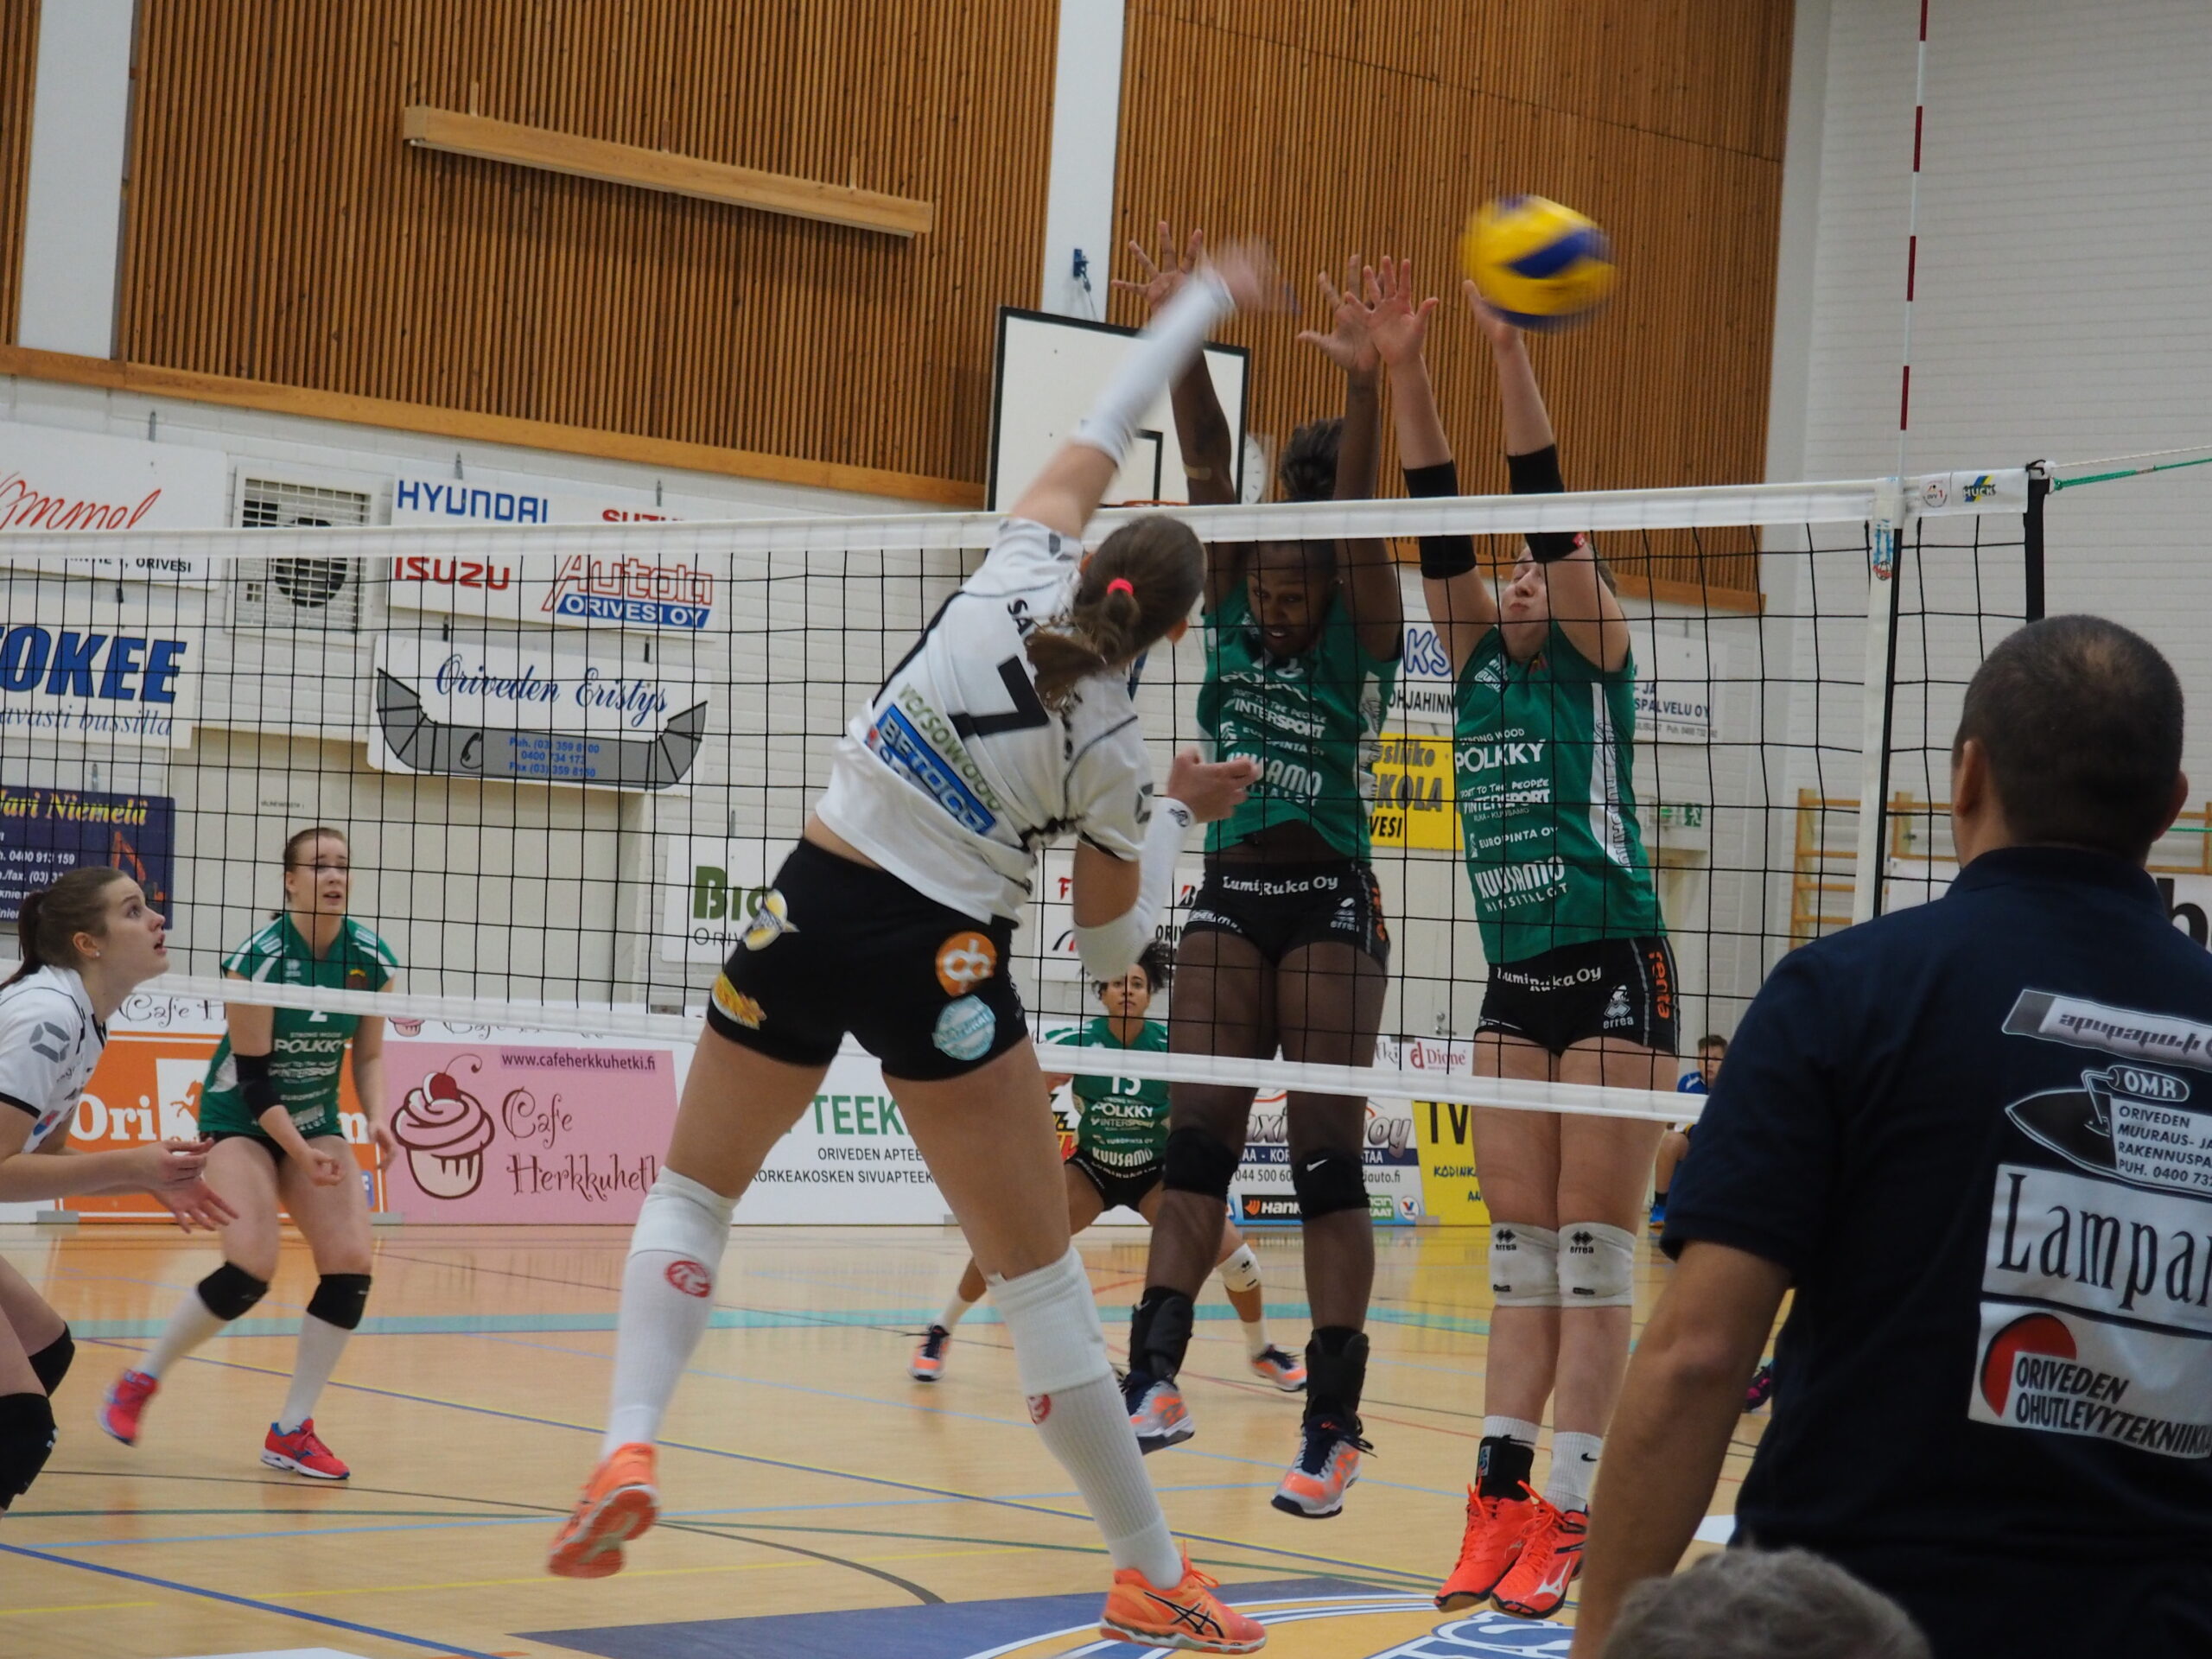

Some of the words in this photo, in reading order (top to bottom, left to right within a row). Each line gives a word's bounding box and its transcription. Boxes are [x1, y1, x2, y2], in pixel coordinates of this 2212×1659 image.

[397, 480, 548, 524] HYUNDAI
[136, 558, 192, 574] ORIVESI
[395, 556, 510, 591] ISUZU
[565, 595, 664, 623] ORIVESI
[670, 607, 703, 630] OY
[0, 626, 188, 703] OKEE
[436, 654, 560, 702] Oriveden
[575, 667, 669, 728] Eristys
[947, 654, 1049, 740] 7
[576, 744, 600, 753] 800
[45, 793, 149, 827] Niemelä
[57, 855, 75, 865] 159
[1313, 876, 1339, 890] Oy
[1603, 1016, 1635, 1029] errea
[501, 1053, 656, 1071] www.cafeherkkuhetki.fi
[2124, 1070, 2177, 1098] OMR
[502, 1087, 573, 1149] Cafe
[2119, 1105, 2190, 1129] ORIVEDEN
[2117, 1123, 2195, 1147] MUURAUS-
[817, 1147, 880, 1161] ORIVEDEN
[884, 1148, 923, 1162] APTEE
[2118, 1141, 2212, 1169] RAKENNUSPA
[1257, 1170, 1277, 1182] 500
[2119, 1159, 2147, 1176] PUH.
[2152, 1166, 2189, 1182] 0400
[1569, 1245, 1595, 1255] errea
[2015, 1356, 2130, 1405] ORIVEDEN
